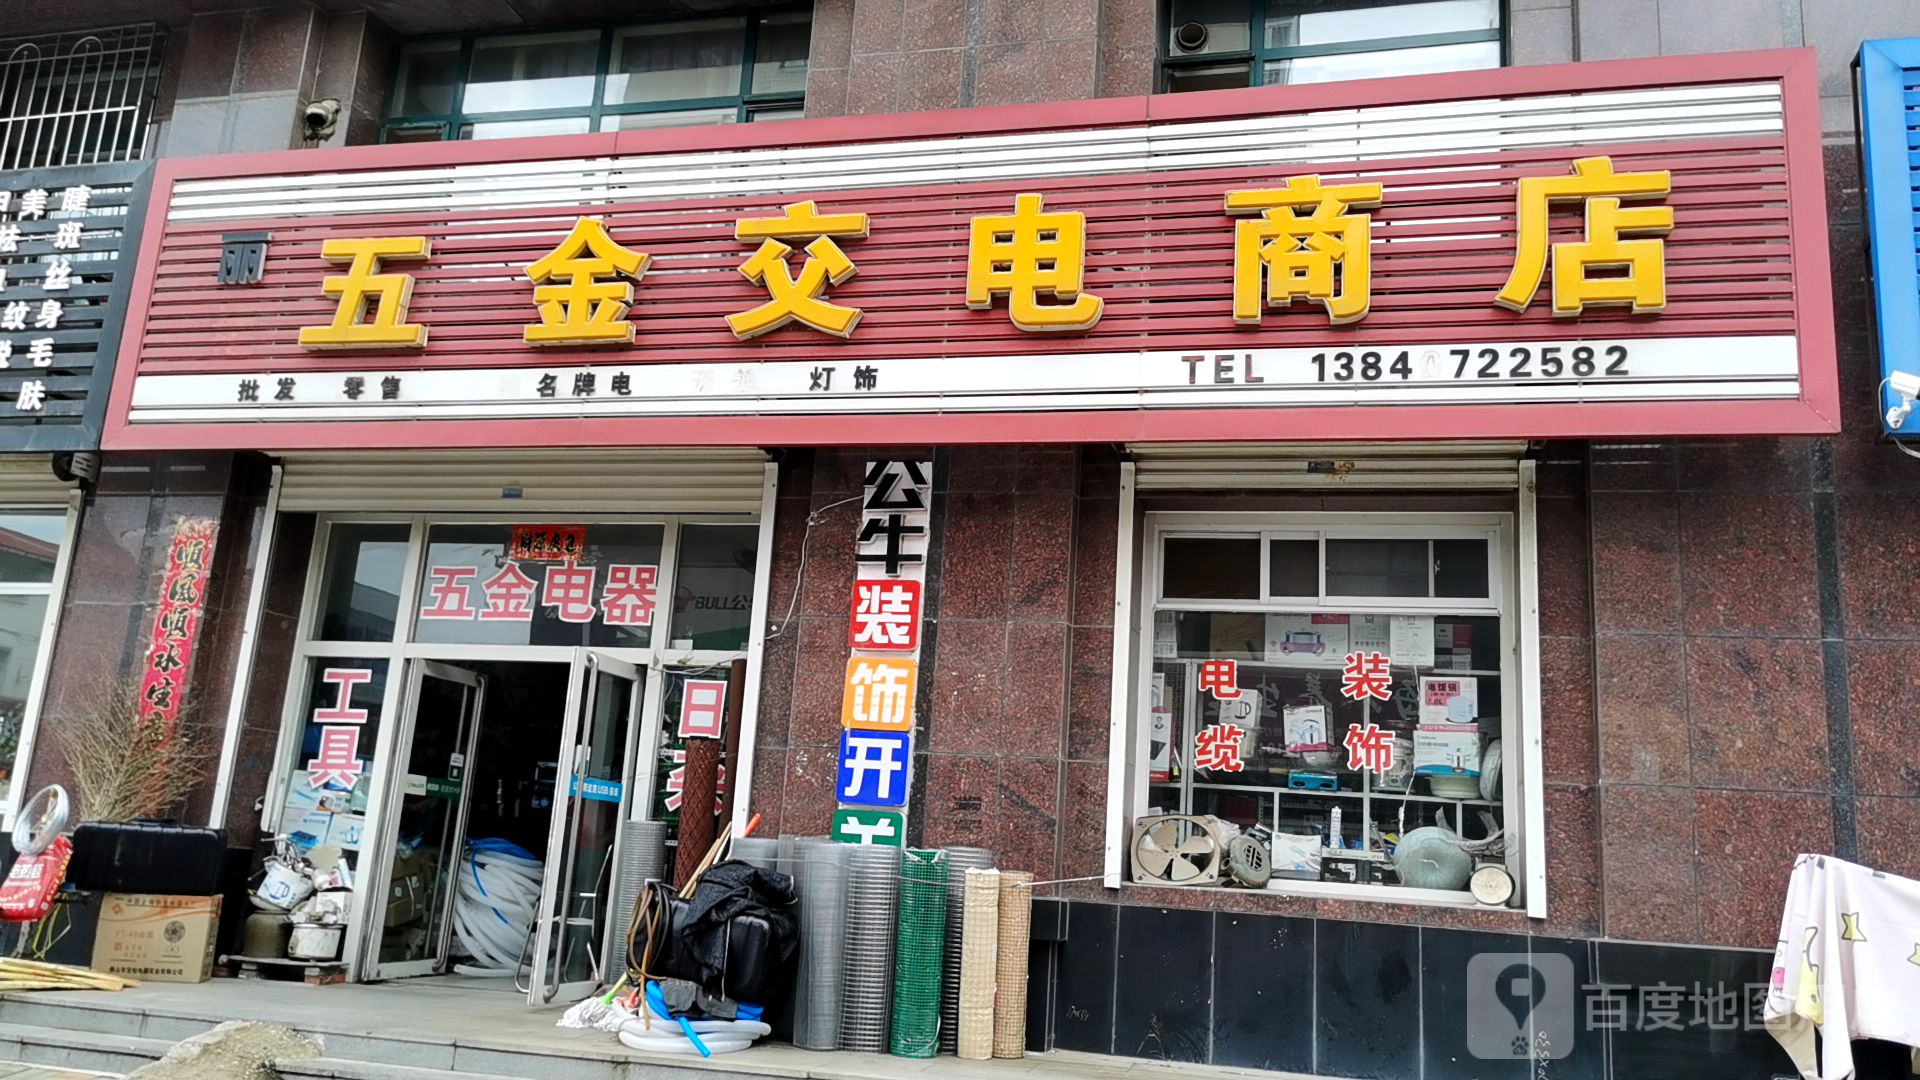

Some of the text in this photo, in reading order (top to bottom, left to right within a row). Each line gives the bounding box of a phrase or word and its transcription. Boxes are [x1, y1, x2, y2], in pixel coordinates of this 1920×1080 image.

[298, 156, 1675, 352] 五金交电商店
[1, 299, 63, 330] 纹身
[16, 379, 46, 411] 肤
[238, 376, 297, 401] 批发
[342, 375, 402, 400] 零售
[536, 371, 632, 398] 名牌电
[809, 364, 878, 392] 灯饰
[1181, 354, 1265, 384] TEL
[420, 560, 659, 627] 五金电器
[307, 668, 373, 791] 工具
[1194, 658, 1245, 773] 电缆
[1340, 650, 1396, 775] 装饰
